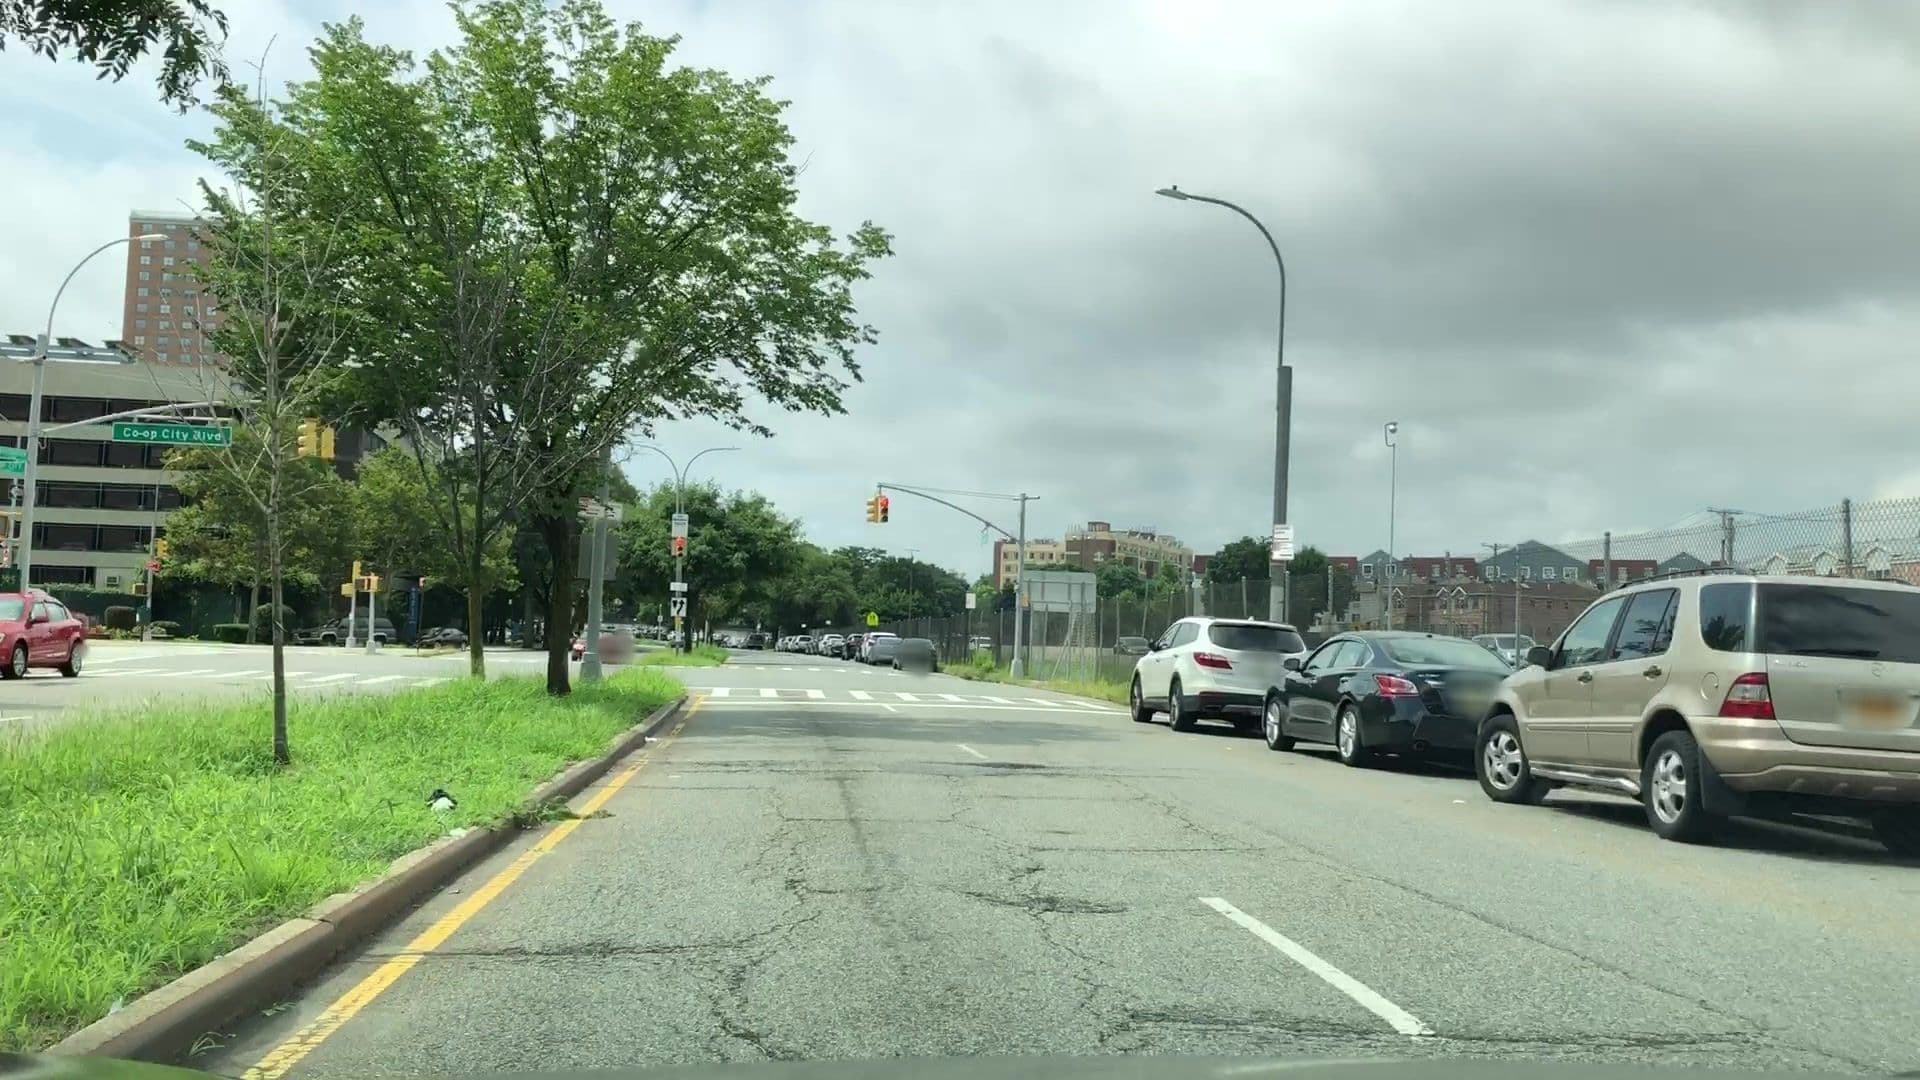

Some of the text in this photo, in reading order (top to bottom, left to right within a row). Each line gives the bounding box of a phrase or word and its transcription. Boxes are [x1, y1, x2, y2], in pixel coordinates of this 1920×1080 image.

[123, 427, 221, 441] Co-op City Blvd
